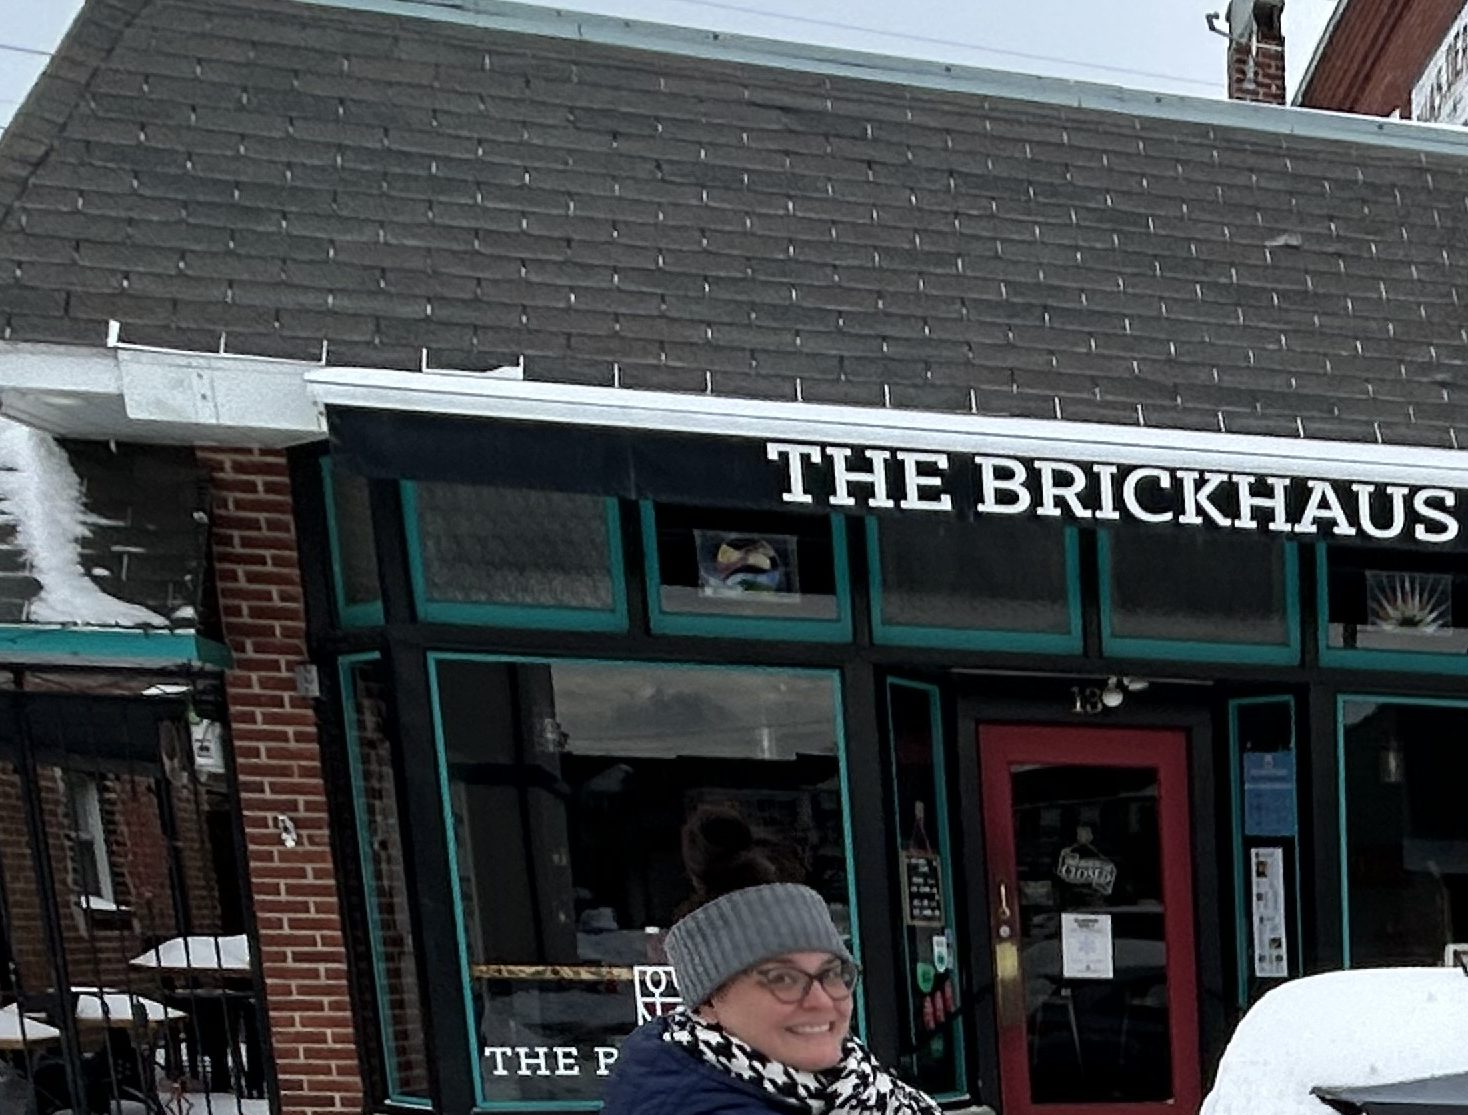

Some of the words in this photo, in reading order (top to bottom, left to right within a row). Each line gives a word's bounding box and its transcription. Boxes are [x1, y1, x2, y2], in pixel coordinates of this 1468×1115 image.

[766, 442, 952, 511] THE
[974, 454, 1460, 543] BRICKHAUS
[484, 1046, 580, 1076] THE
